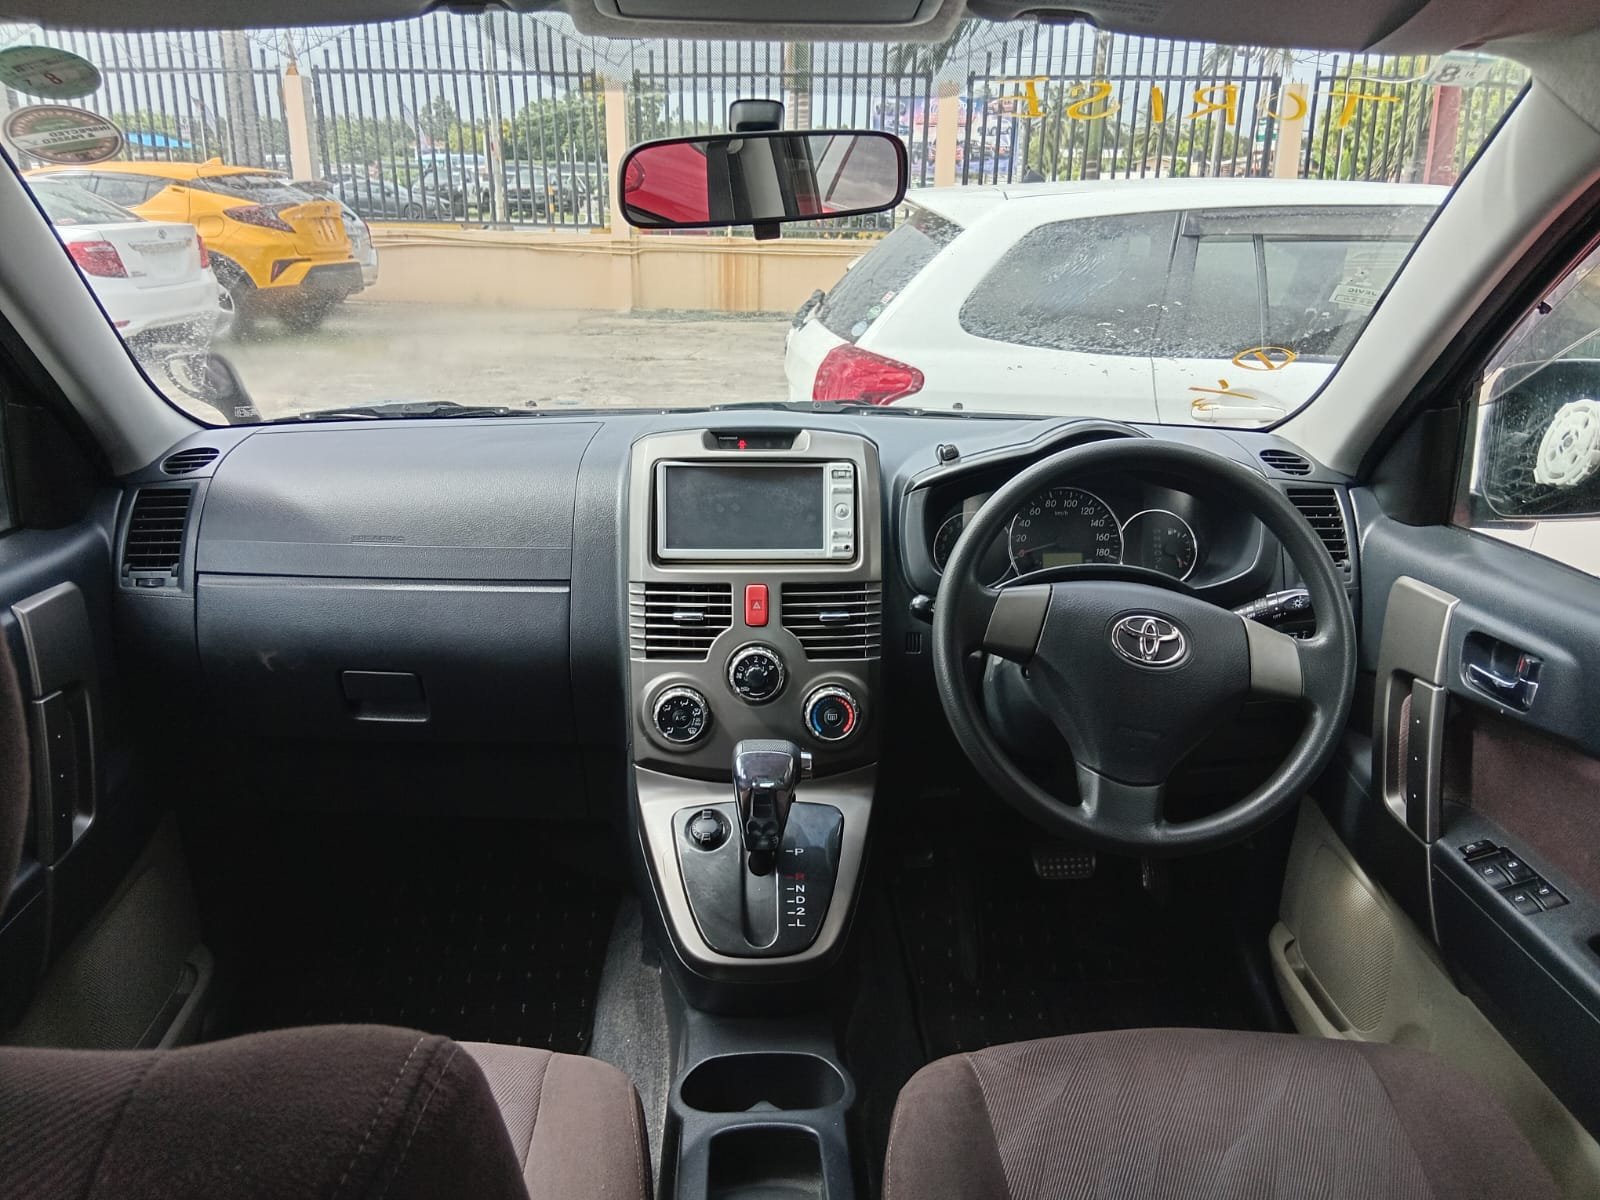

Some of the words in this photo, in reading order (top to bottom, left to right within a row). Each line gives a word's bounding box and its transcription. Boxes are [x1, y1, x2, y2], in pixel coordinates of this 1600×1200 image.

[1045, 500, 1057, 508] 80
[1063, 500, 1078, 508] 100
[1029, 507, 1041, 515] 60
[1080, 507, 1095, 516] 120
[1019, 519, 1031, 527] 40
[1090, 519, 1105, 527] 140
[1016, 534, 1027, 542] 20
[1095, 533, 1110, 541] 160
[1096, 549, 1110, 557] 180
[753, 655, 759, 663] 2
[794, 847, 805, 856] P
[795, 884, 805, 893] N
[795, 895, 806, 904] D
[796, 906, 806, 916] 2
[796, 918, 807, 927] L
